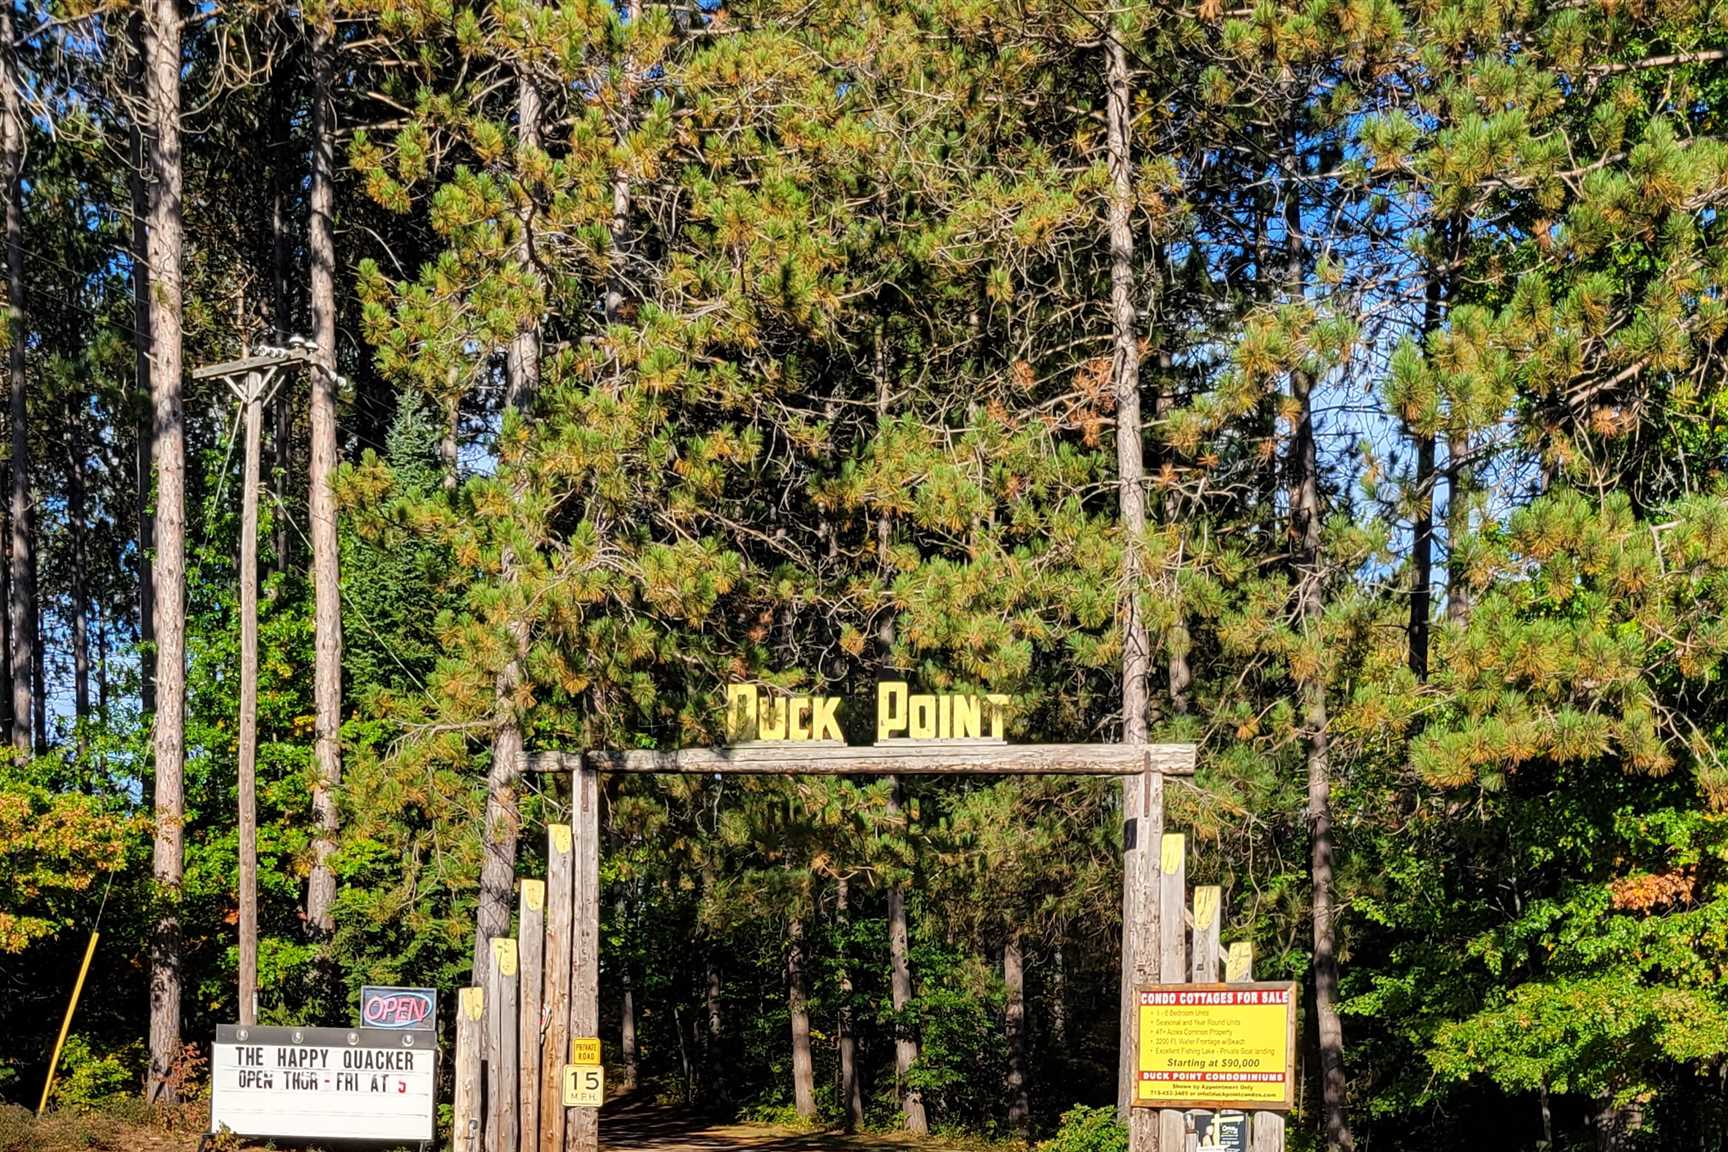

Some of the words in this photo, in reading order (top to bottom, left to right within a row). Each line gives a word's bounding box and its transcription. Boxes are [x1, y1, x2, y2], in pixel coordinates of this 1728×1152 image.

[727, 683, 844, 742] DUCK
[878, 681, 1011, 739] POINT
[1141, 992, 1176, 1004] CONDO
[1180, 992, 1233, 1004] COTTAGES
[1237, 992, 1258, 1004] FOR
[1262, 992, 1288, 1003] SALE
[365, 996, 427, 1022] OPEN
[575, 1043, 597, 1051] PRIVATE
[236, 1047, 264, 1066] THE
[277, 1048, 329, 1068] HAPPY
[343, 1050, 414, 1070] QUACKER
[1167, 1058, 1206, 1069] Starting
[1208, 1059, 1218, 1067] at
[1222, 1059, 1260, 1068] $90,000
[239, 1070, 273, 1089] OPEN
[336, 1072, 359, 1092] FRI
[370, 1073, 390, 1093] AT
[571, 1071, 599, 1090] 15
[1143, 1072, 1170, 1080] DUCK
[1173, 1072, 1202, 1080] POINT
[1206, 1073, 1283, 1081] CONDOMINIUMS
